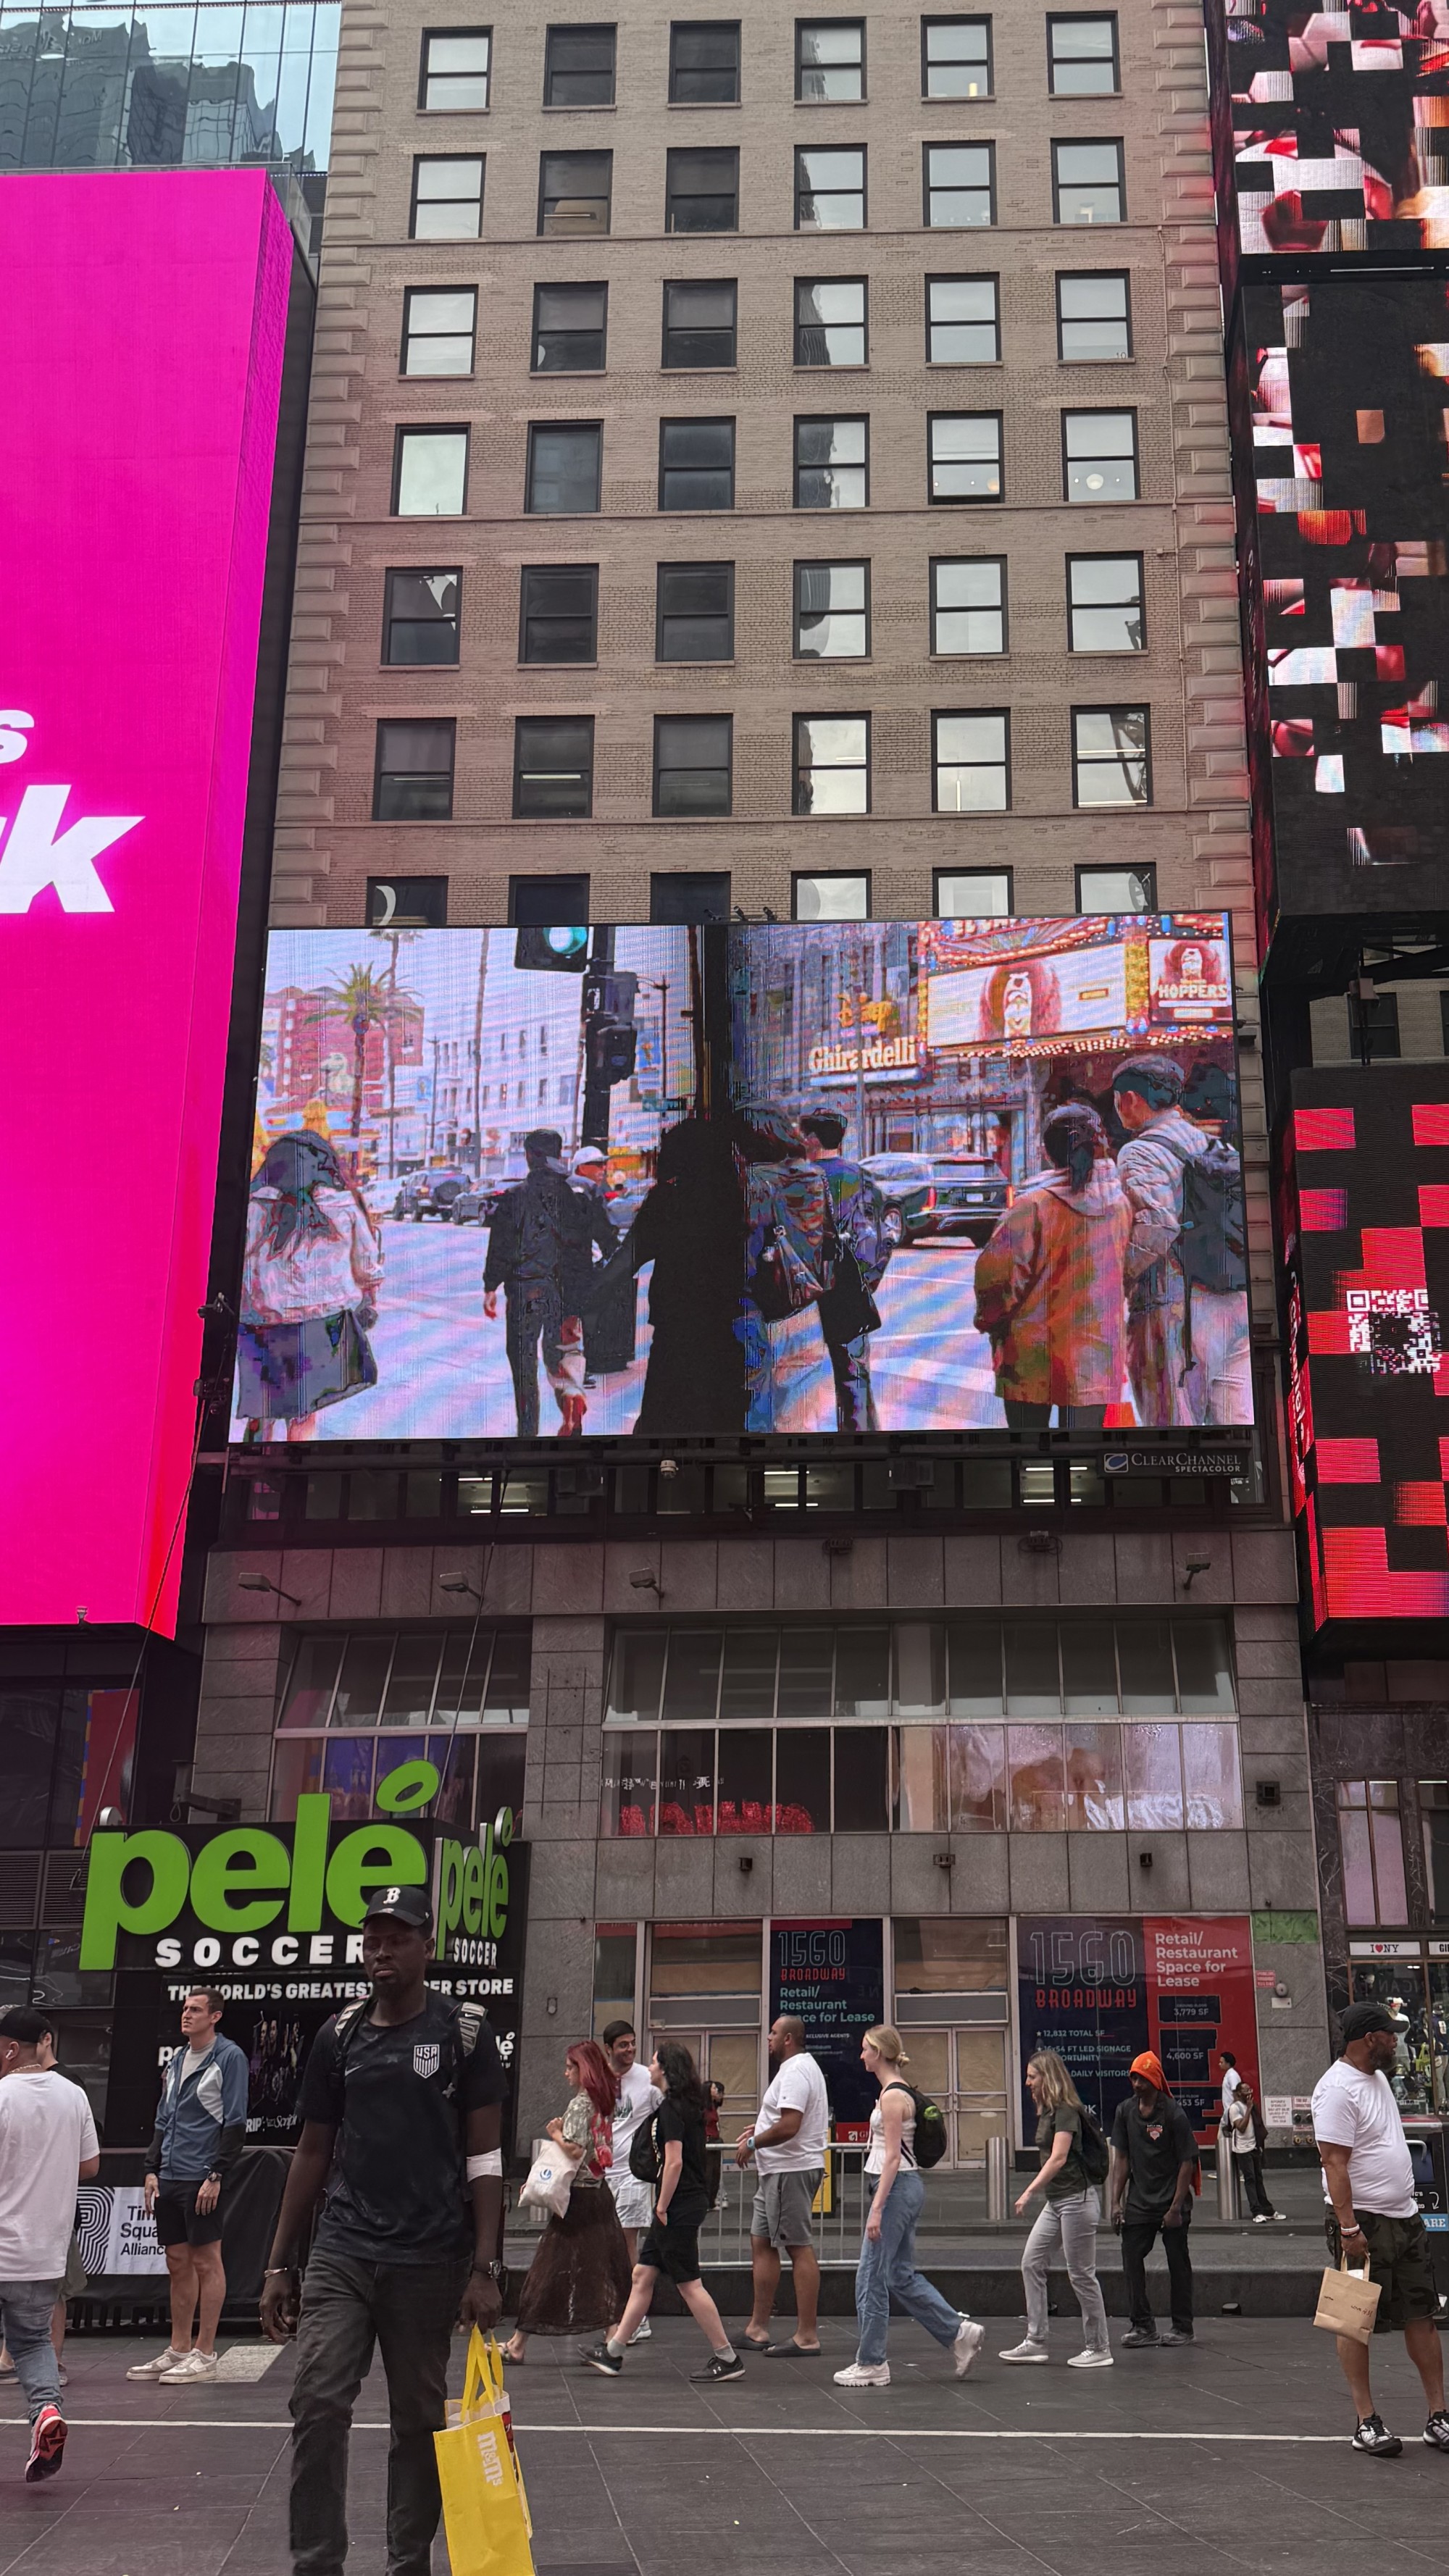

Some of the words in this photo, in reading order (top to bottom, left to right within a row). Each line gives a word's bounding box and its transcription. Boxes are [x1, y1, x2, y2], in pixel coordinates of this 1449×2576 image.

[0, 785, 146, 913] k
[1158, 984, 1227, 998] HOPPERS
[79, 1760, 440, 1970] pelé
[436, 1807, 513, 1960] pelé
[383, 1887, 401, 1904] B
[1156, 1931, 1203, 1945] Retail/
[454, 1937, 497, 1966] SOCCER
[779, 1931, 845, 1966] 1560
[1156, 1947, 1237, 1959] Restaurant
[1030, 1931, 1135, 1986] 1560
[780, 1967, 845, 1981] BROADWAY
[1156, 1961, 1200, 1975] Space
[1205, 1960, 1226, 1972] for
[456, 1978, 513, 1996] STORE
[1158, 1975, 1200, 1986] Lease
[206, 1983, 283, 1999] ORLD'S
[780, 1986, 819, 1998] Retail/
[780, 1999, 847, 2010] Restaurant
[1036, 1989, 1137, 2009] BROADWAY
[819, 2012, 837, 2022] for
[840, 2012, 875, 2022] Lease
[1174, 2008, 1196, 2017] 3,779
[417, 2047, 437, 2059] USA
[1166, 2052, 1191, 2061] 4,600
[120, 2222, 157, 2241] Squa
[120, 2243, 164, 2256] Allianc
